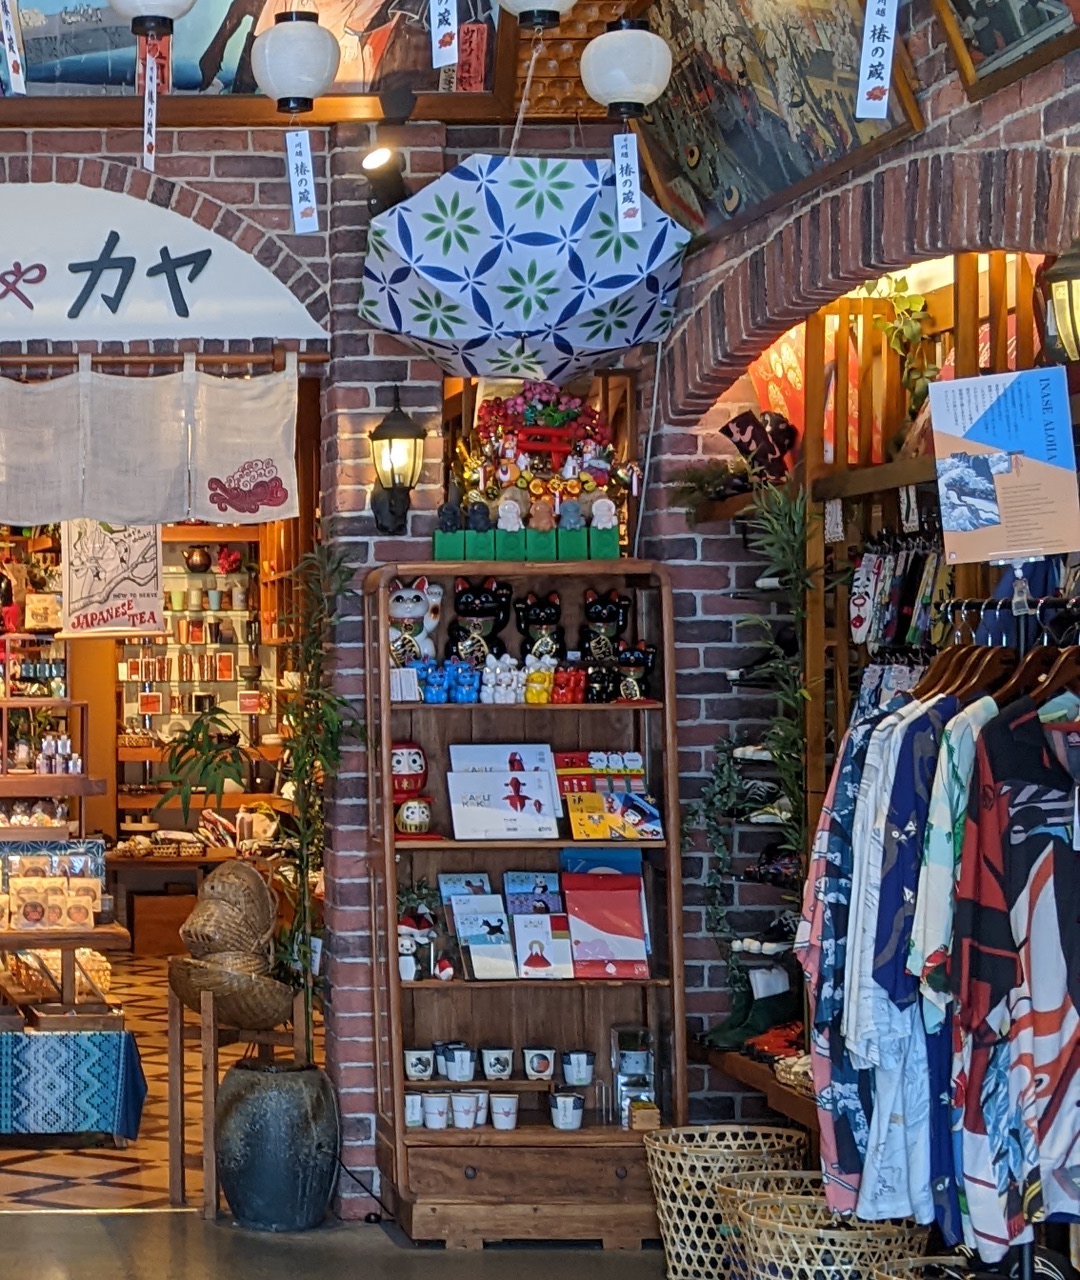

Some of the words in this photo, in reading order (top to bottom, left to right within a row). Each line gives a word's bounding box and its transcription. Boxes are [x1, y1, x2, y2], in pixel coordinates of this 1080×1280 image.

[866, 23, 891, 82] 椿の蔵
[294, 161, 311, 205] 椿の蔵
[618, 162, 635, 205] 椿の蔵
[67, 230, 212, 319] カヤ
[1039, 377, 1052, 415] INASE
[1043, 420, 1058, 462] ALOHA
[70, 599, 134, 629] JAPANESE
[128, 611, 157, 627] TEA
